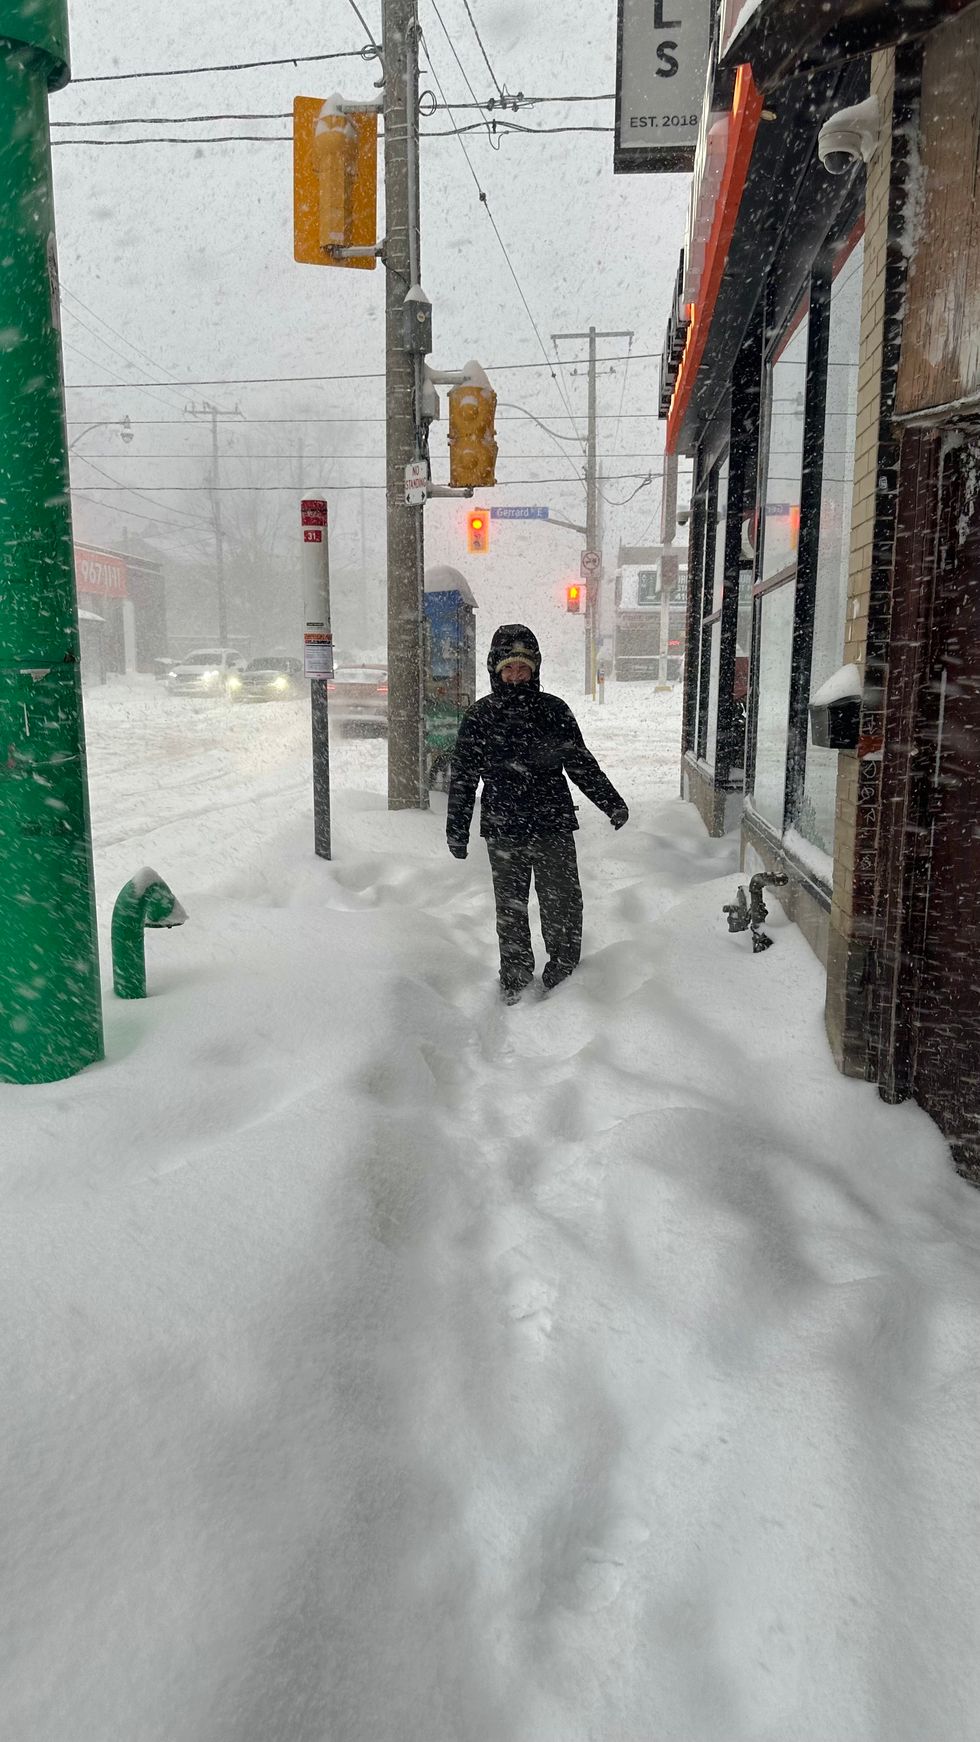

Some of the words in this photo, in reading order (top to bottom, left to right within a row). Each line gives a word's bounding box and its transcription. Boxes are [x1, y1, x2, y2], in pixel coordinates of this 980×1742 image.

[630, 116, 658, 128] EST.
[662, 114, 698, 127] 2018
[411, 465, 420, 476] NO
[496, 507, 529, 517] Gerrard
[537, 508, 543, 517] E
[307, 532, 317, 541] 31
